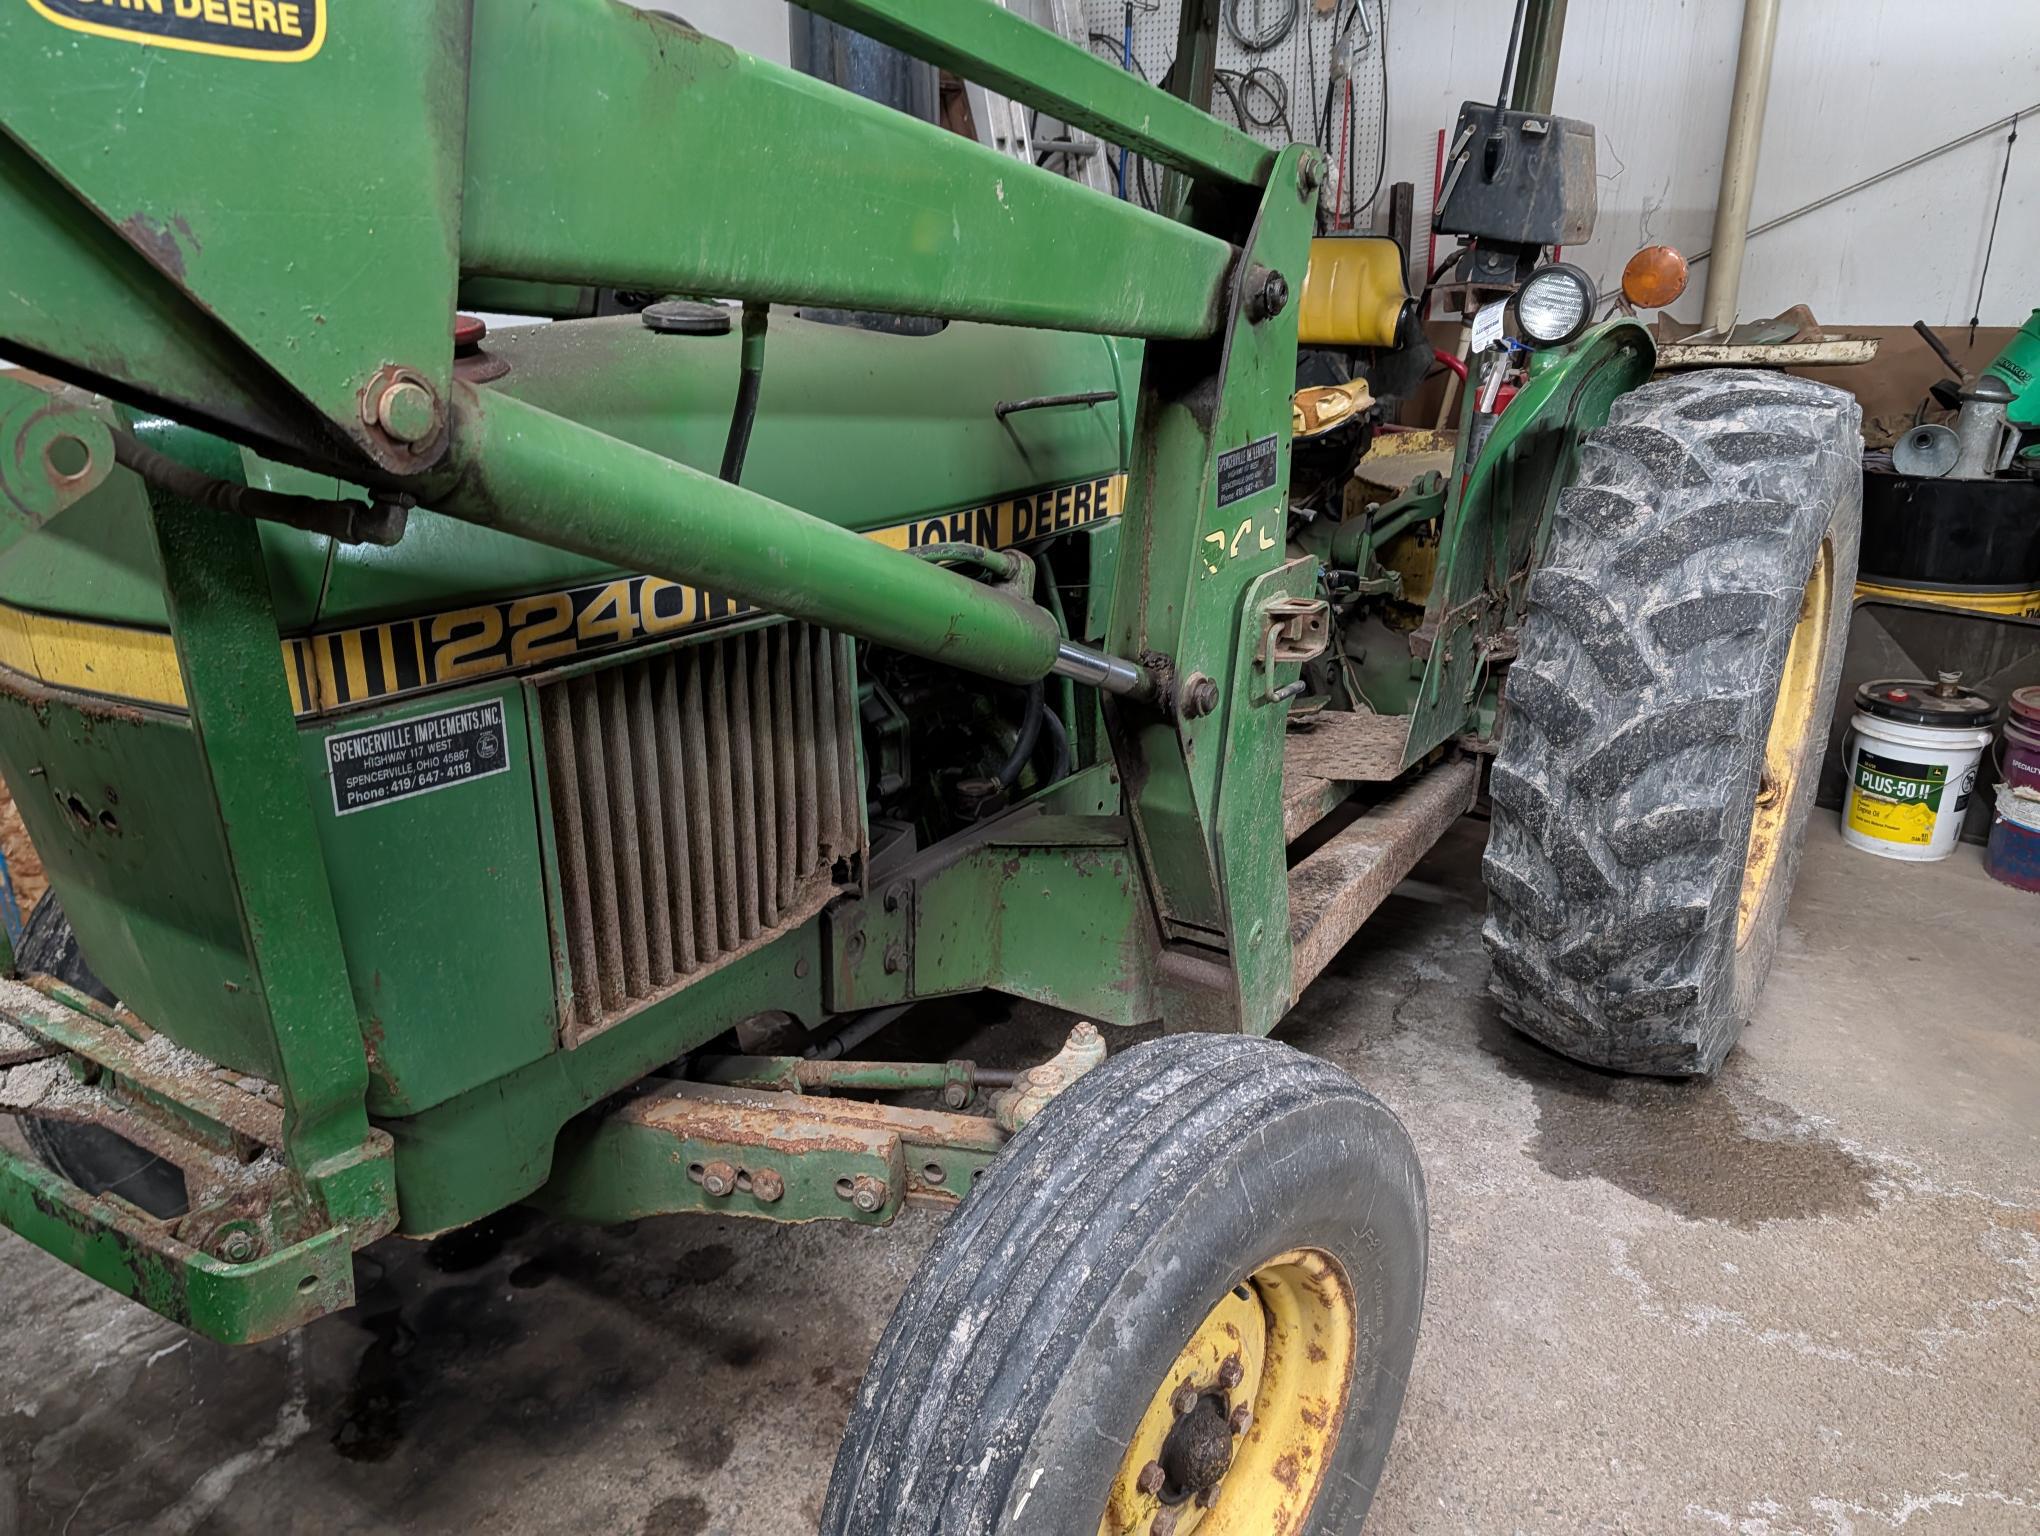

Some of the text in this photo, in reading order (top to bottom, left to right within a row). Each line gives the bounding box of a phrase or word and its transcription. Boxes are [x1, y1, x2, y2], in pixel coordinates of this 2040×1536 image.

[172, 0, 303, 37] DEERE
[1011, 478, 1110, 543] DEERE
[431, 576, 697, 683] 2240
[332, 726, 412, 763] SPENCERVILLE
[363, 739, 453, 770] HIGHWAY 117 WEST
[1861, 771, 1917, 798] PLUS-50
